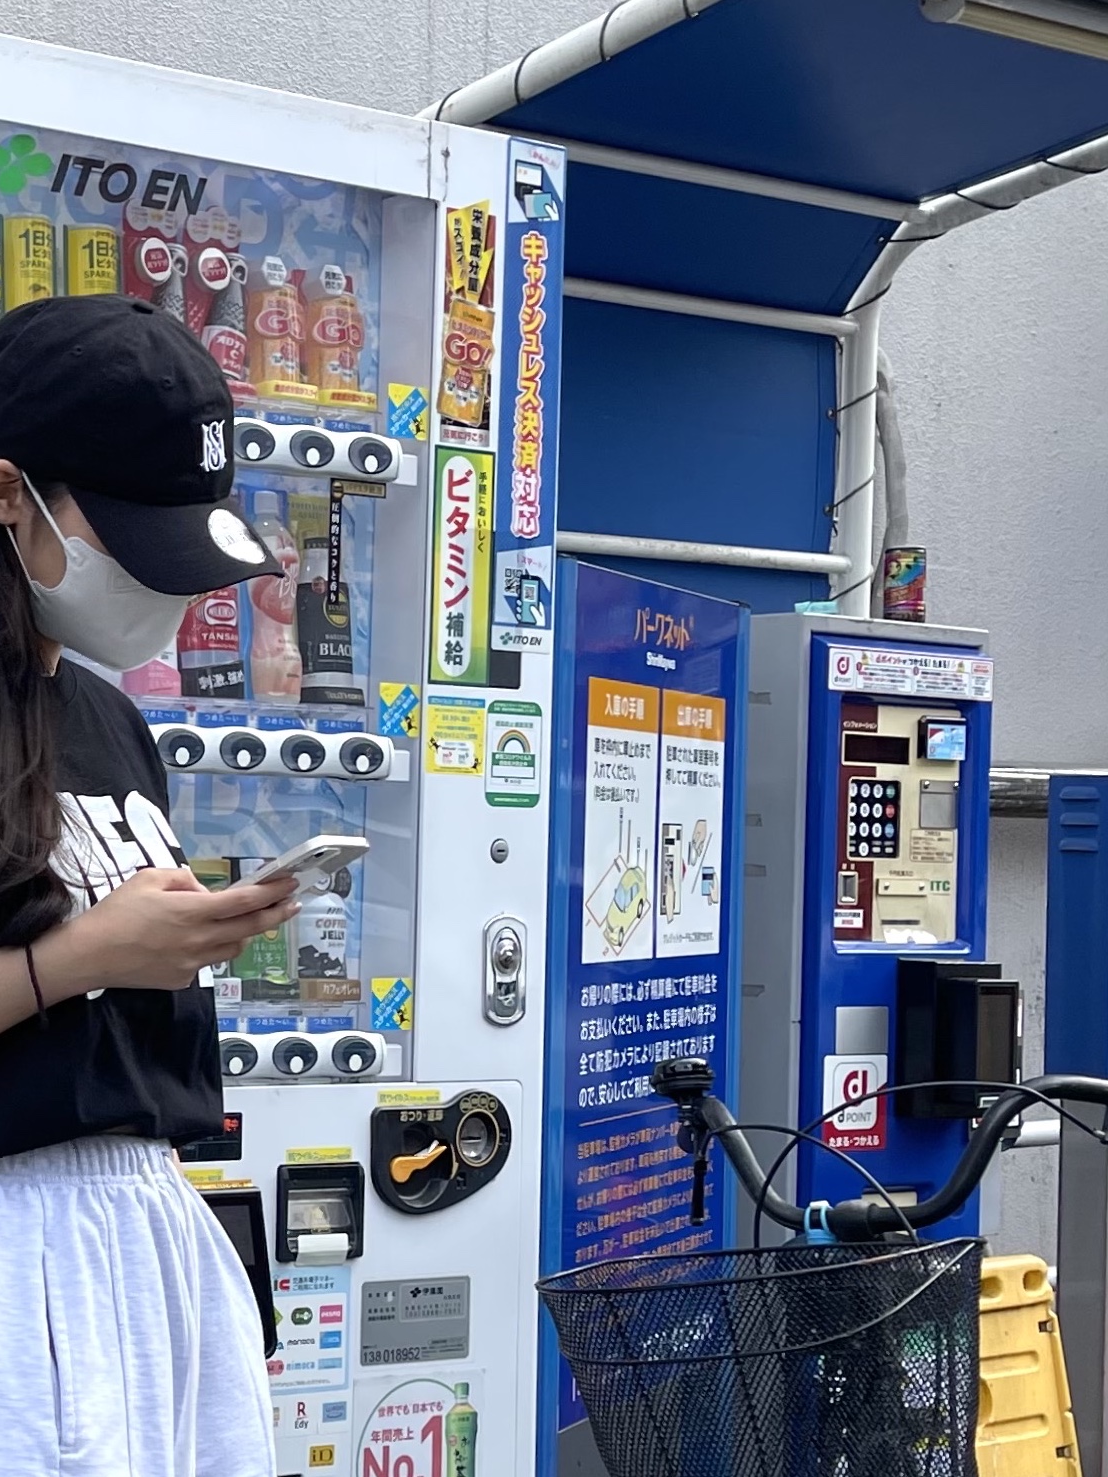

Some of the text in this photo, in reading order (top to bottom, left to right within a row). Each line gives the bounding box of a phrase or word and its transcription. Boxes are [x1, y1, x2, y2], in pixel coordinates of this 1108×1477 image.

[50, 153, 208, 216] ITO EN
[511, 231, 549, 540] キャッシュレス決済対応
[444, 467, 474, 667] ビタミン補給
[512, 634, 543, 646] ITO EN
[604, 692, 645, 721] 入庫の手順
[676, 704, 714, 729] 出庫の手順
[846, 1112, 872, 1123] POINT
[370, 1426, 415, 1444] 年間売上
